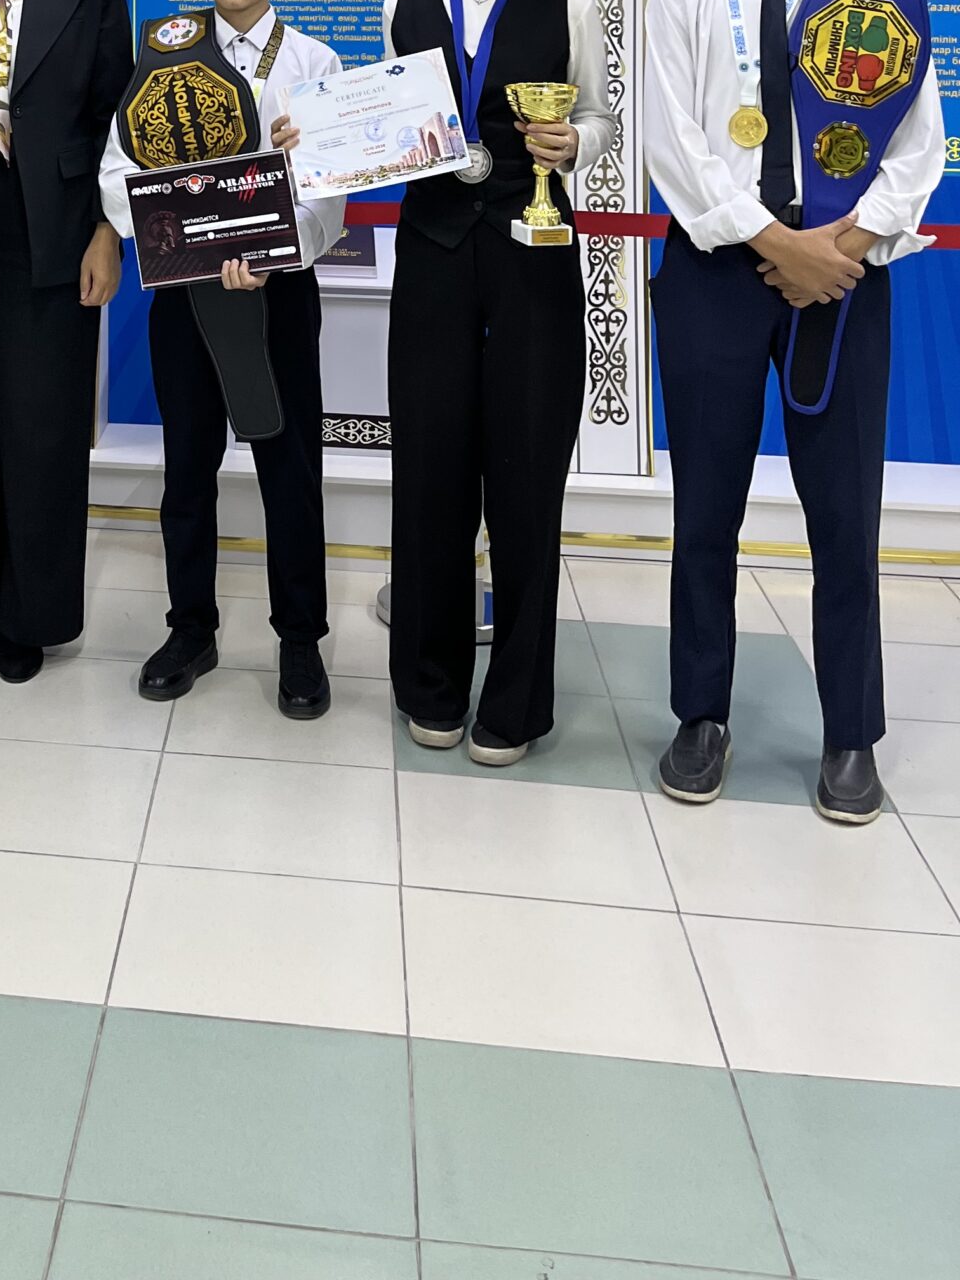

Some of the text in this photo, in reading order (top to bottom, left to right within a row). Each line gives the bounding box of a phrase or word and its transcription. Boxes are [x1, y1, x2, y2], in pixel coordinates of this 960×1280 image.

[824, 20, 844, 76] CHAMPION
[836, 10, 865, 88] BOXING
[173, 80, 201, 162] CHAMPION
[217, 171, 284, 188] ARALKEY
[227, 181, 274, 192] GLADIATOR
